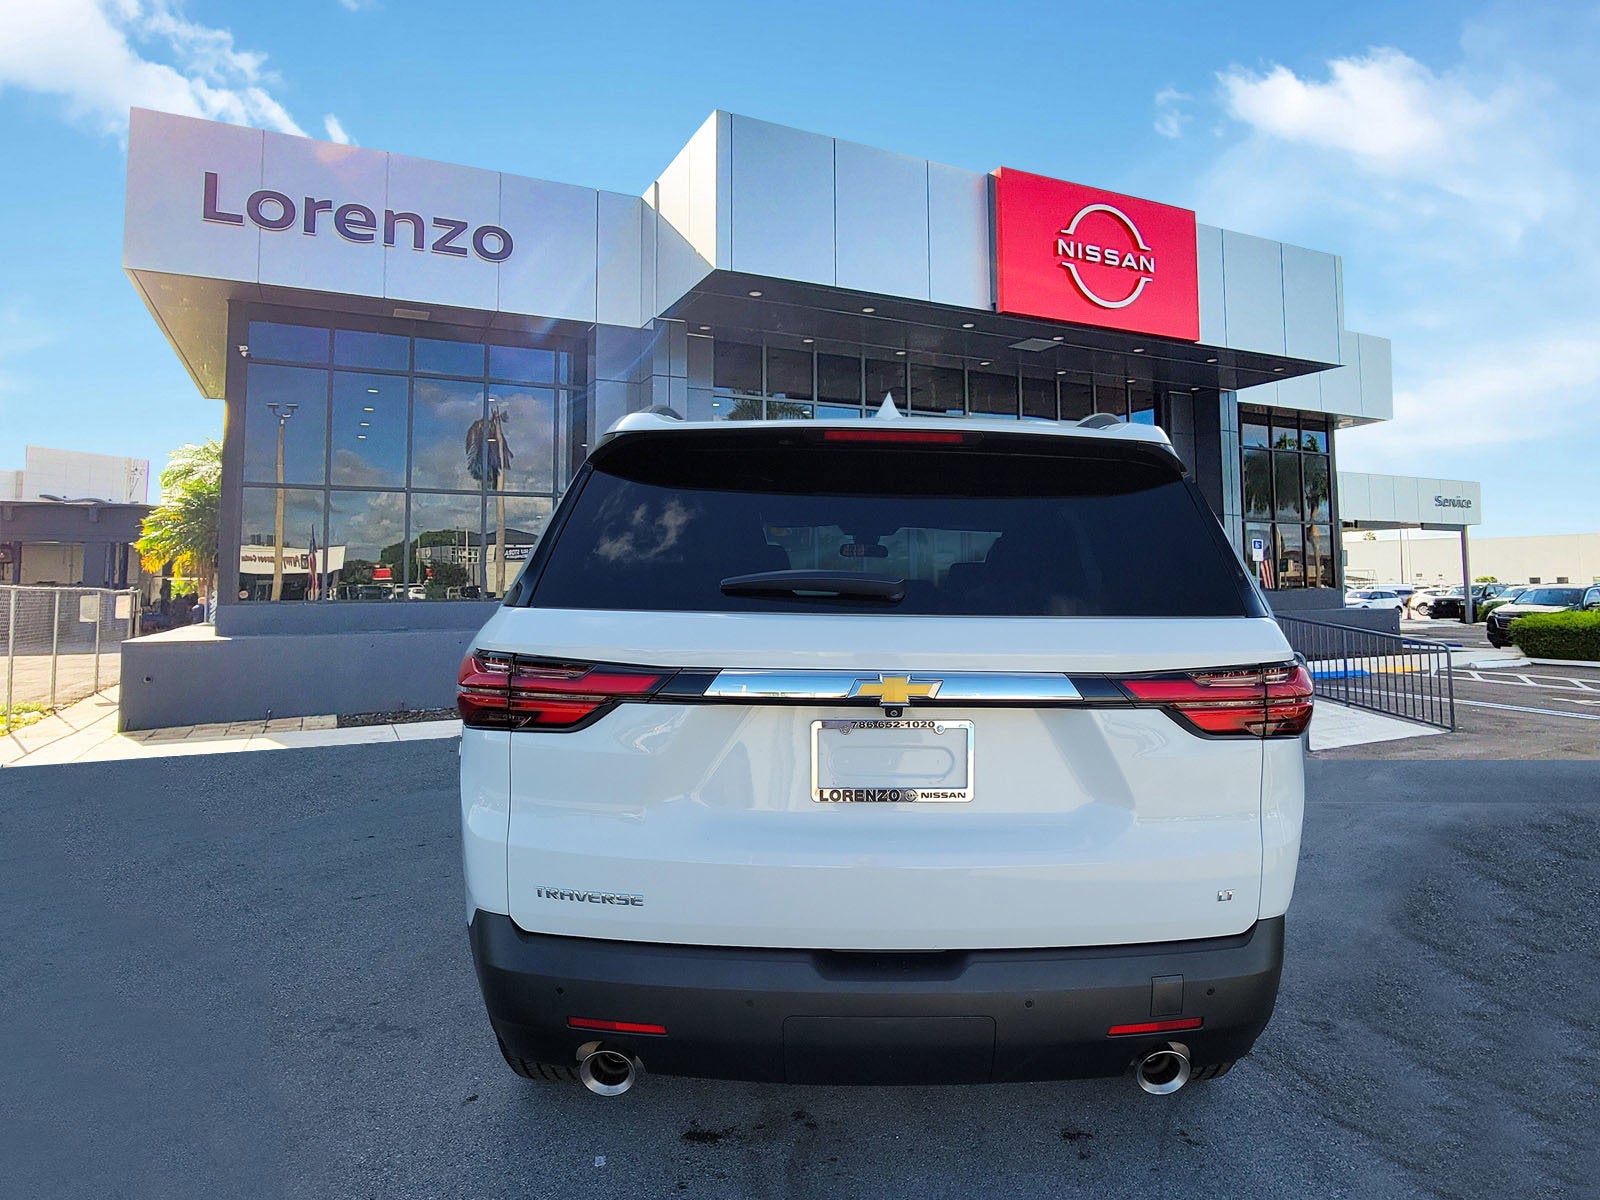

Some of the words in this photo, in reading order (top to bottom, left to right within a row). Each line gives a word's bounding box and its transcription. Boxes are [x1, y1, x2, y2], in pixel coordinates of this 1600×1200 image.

[203, 170, 515, 263] Lorenzo
[1056, 237, 1156, 274] NISSAN
[1434, 495, 1472, 509] Service
[819, 789, 900, 802] LORENZO
[536, 885, 644, 907] TRAVERSE
[1217, 889, 1235, 902] LT
